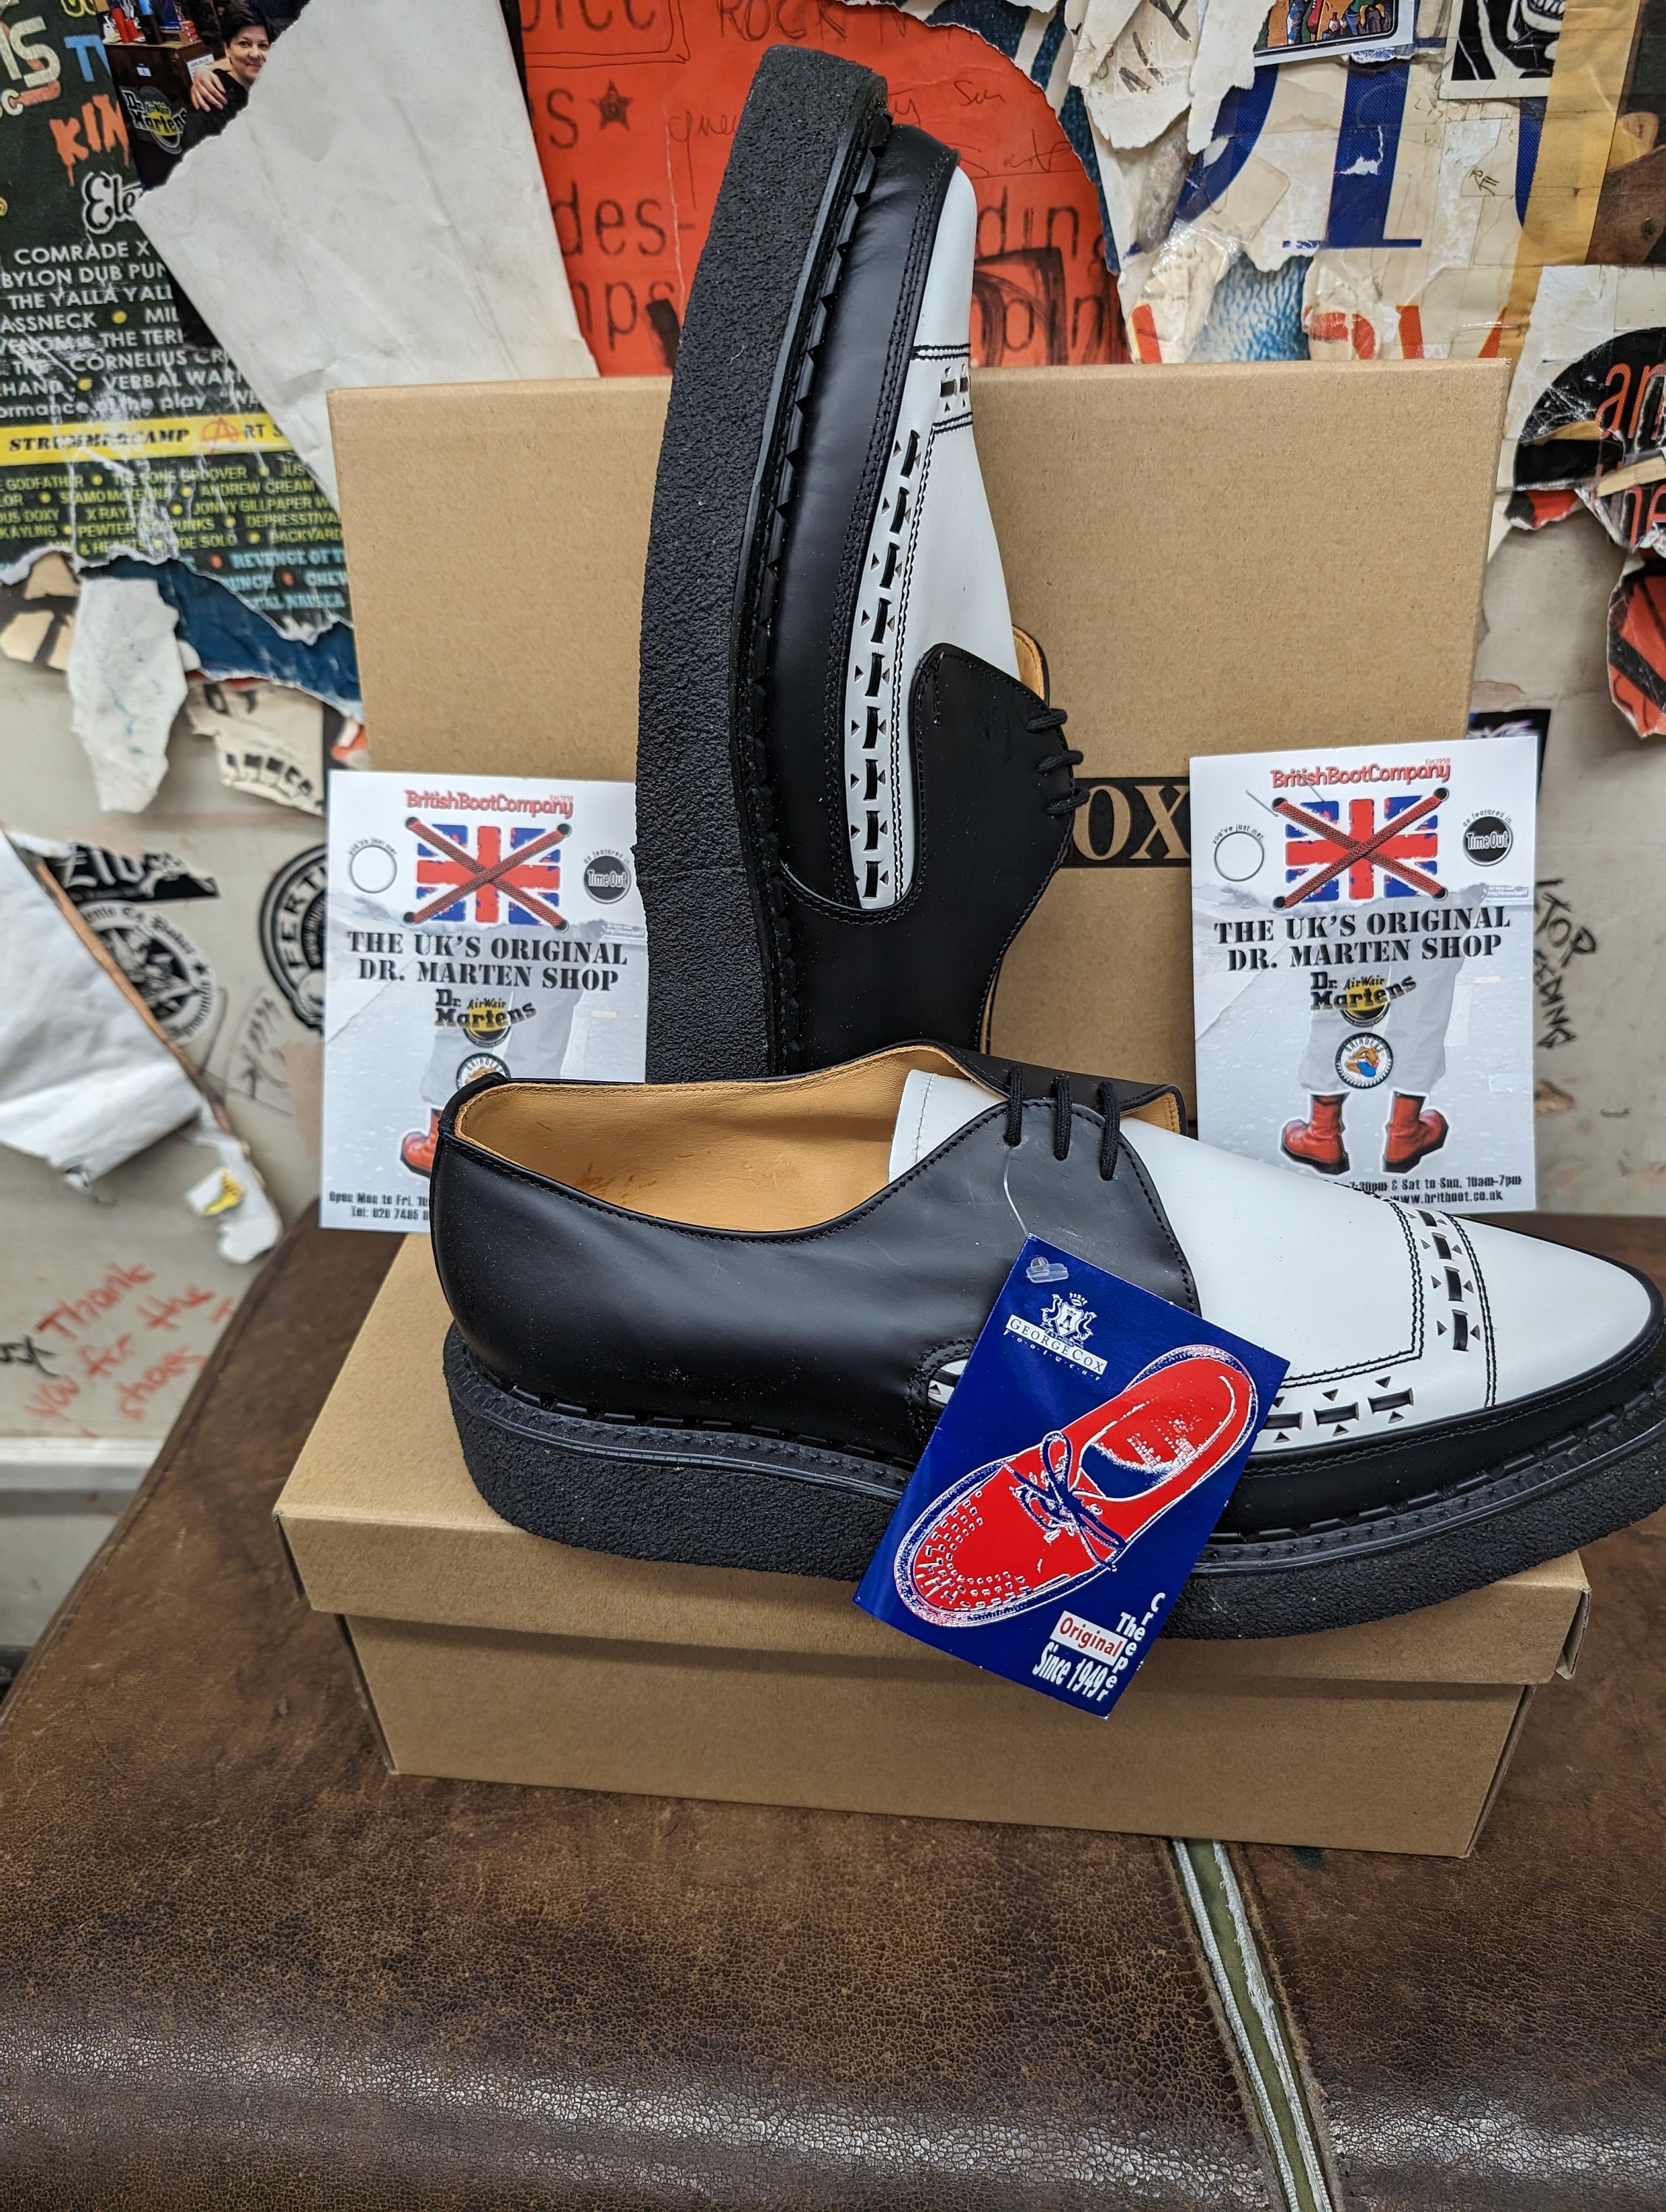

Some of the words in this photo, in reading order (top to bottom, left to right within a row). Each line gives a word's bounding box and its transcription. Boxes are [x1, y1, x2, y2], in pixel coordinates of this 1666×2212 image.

[14, 241, 129, 265] COMRADE
[79, 265, 123, 284] DUB
[7, 293, 46, 310] THE
[50, 285, 119, 307] YALLA
[99, 332, 138, 349] THE
[69, 349, 187, 372] CORNELIUS
[109, 370, 182, 391] VERBAL
[1270, 762, 1451, 788] BritishBootCompany
[405, 790, 574, 819] BritishBootCompany
[1214, 919, 1274, 945] THE
[1285, 913, 1356, 940] UK'S
[1367, 905, 1510, 935] ORIGINAL
[347, 931, 404, 954] THE
[414, 932, 481, 959] UK'S
[490, 936, 628, 966] ORIGINAL
[1227, 947, 1277, 971] DR.
[1289, 939, 1410, 967] MARTEN
[1421, 933, 1502, 960] SHOP
[359, 959, 406, 981] DR.
[417, 961, 532, 988] MARTEN
[542, 967, 619, 992] SHOP
[1310, 975, 1417, 1011] Martens
[435, 1001, 538, 1027] Martens
[1401, 1179, 1420, 1191] Sat
[1425, 1178, 1436, 1189] to
[329, 1191, 353, 1203] Open
[357, 1192, 378, 1205] Mon
[382, 1194, 392, 1206] to
[1058, 1616, 1124, 1658] Original
[1115, 1611, 1146, 1641] The
[1032, 1641, 1072, 1686] Since
[1066, 1658, 1109, 1698] 1949
